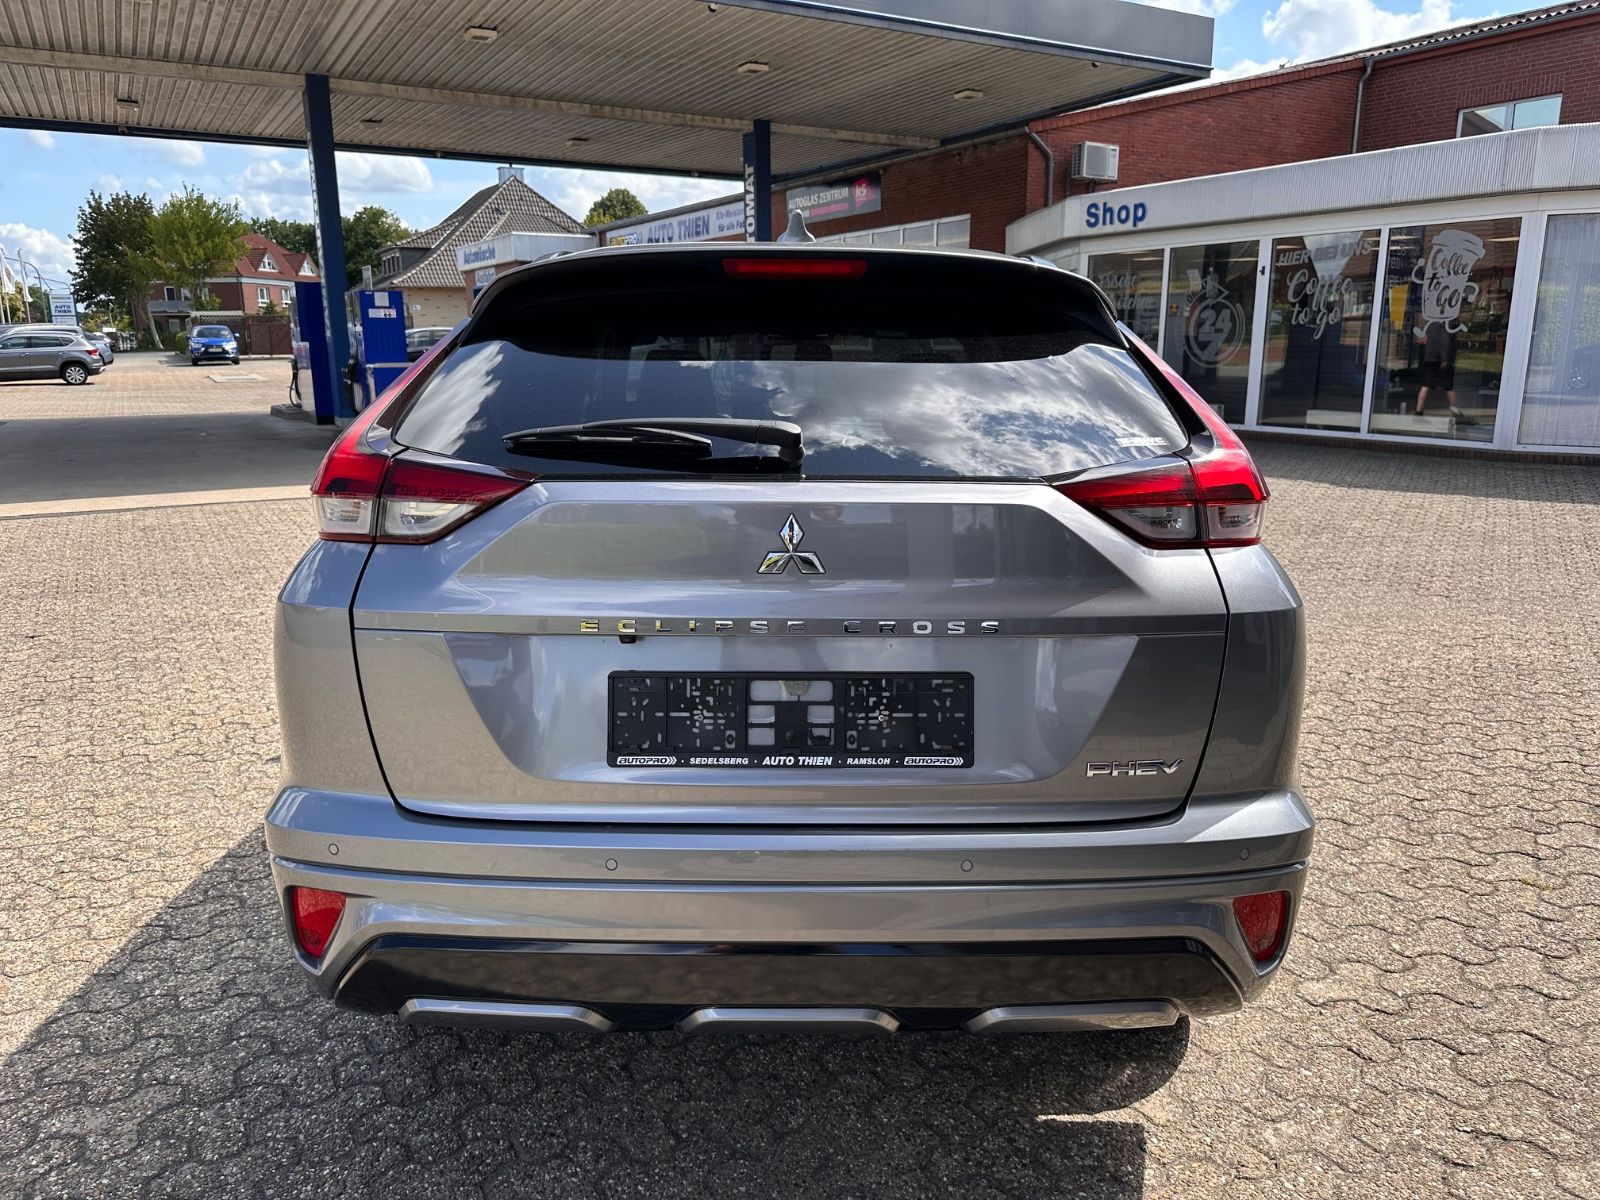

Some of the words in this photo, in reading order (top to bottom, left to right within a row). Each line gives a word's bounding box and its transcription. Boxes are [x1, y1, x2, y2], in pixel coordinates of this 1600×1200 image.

[788, 194, 819, 210] AUTOGLAS
[819, 187, 849, 203] ZENTRUM
[1085, 201, 1147, 229] Shop
[647, 222, 674, 244] AUTO
[676, 214, 710, 240] THIEN
[1279, 250, 1310, 265] HIER
[1339, 240, 1373, 256] UNS
[1431, 248, 1468, 276] Coffee
[1287, 269, 1353, 312] Coffee
[1426, 272, 1442, 293] to
[1199, 308, 1232, 334] 24
[1291, 303, 1310, 325] to
[1313, 307, 1341, 340] go
[580, 618, 805, 634] ECLIPSE
[843, 620, 1000, 635] CROSS
[617, 756, 678, 765] AUTOPRO
[689, 757, 749, 765] SEDELSBERG
[762, 756, 795, 766] AUTO
[798, 756, 833, 766] THIEN
[846, 757, 891, 765] RAMSLOH
[904, 757, 964, 766] AUTOPRO
[1086, 759, 1185, 777] PHEV
